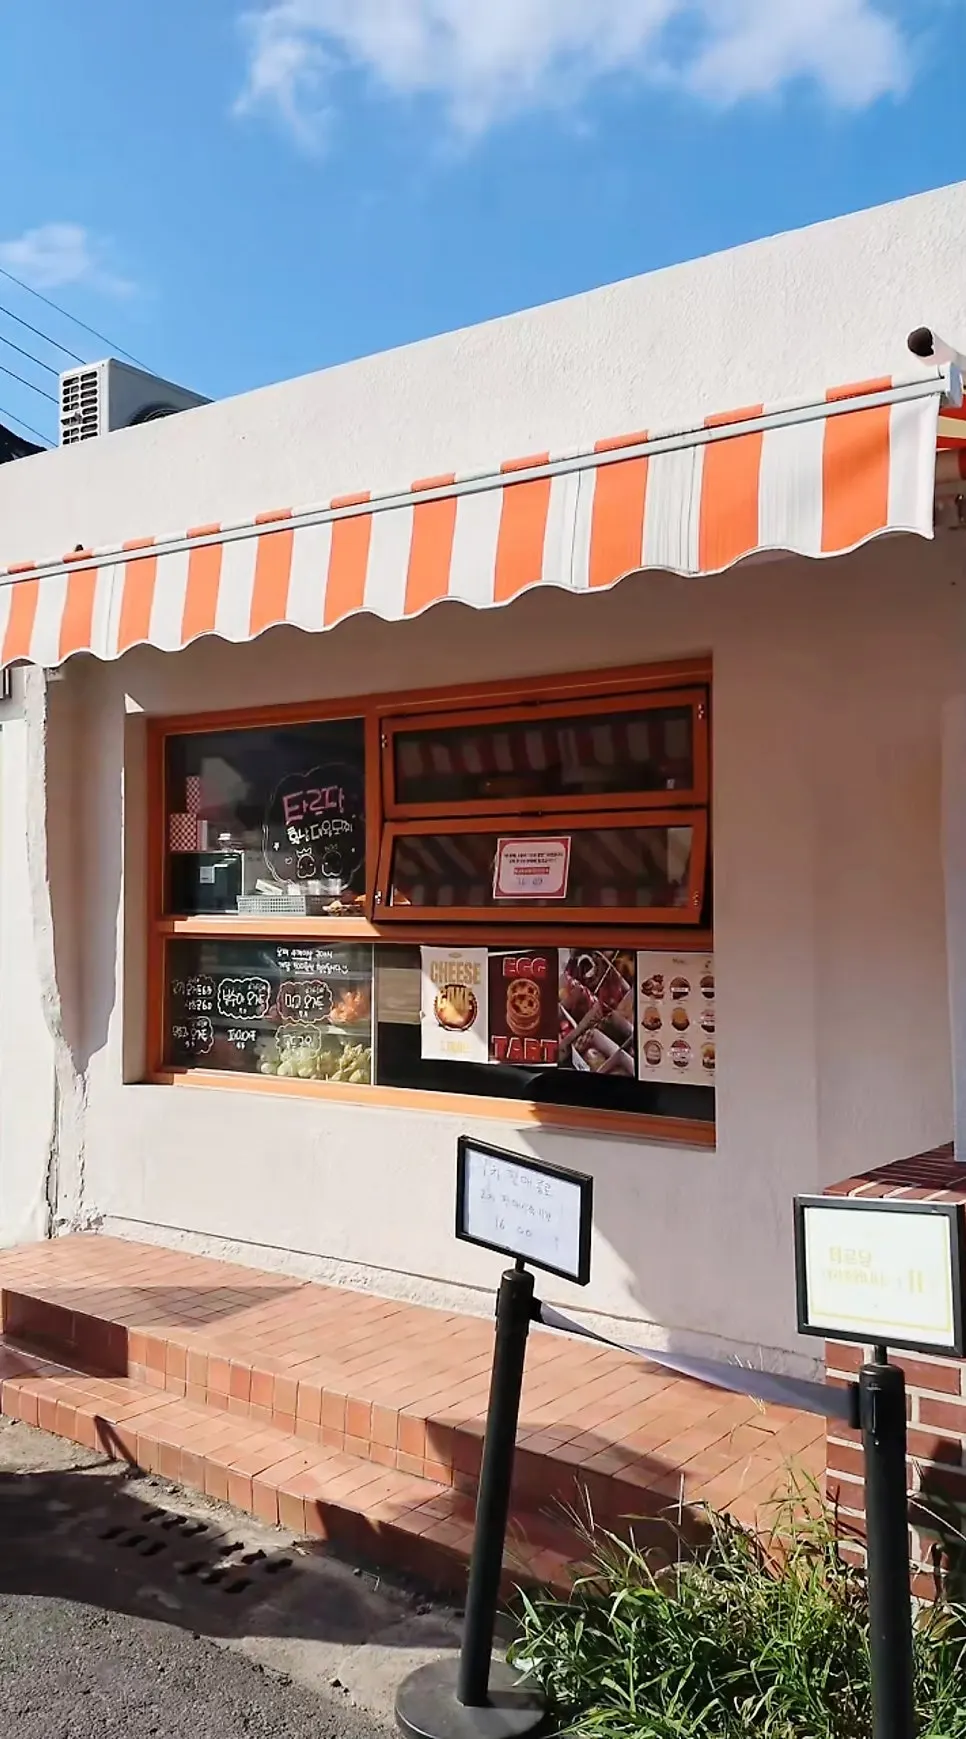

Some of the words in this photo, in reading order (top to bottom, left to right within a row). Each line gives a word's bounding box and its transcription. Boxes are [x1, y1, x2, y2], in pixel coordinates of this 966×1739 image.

[430, 960, 482, 985] CHEESE
[502, 956, 546, 979] EGG
[491, 1034, 558, 1064] TART
